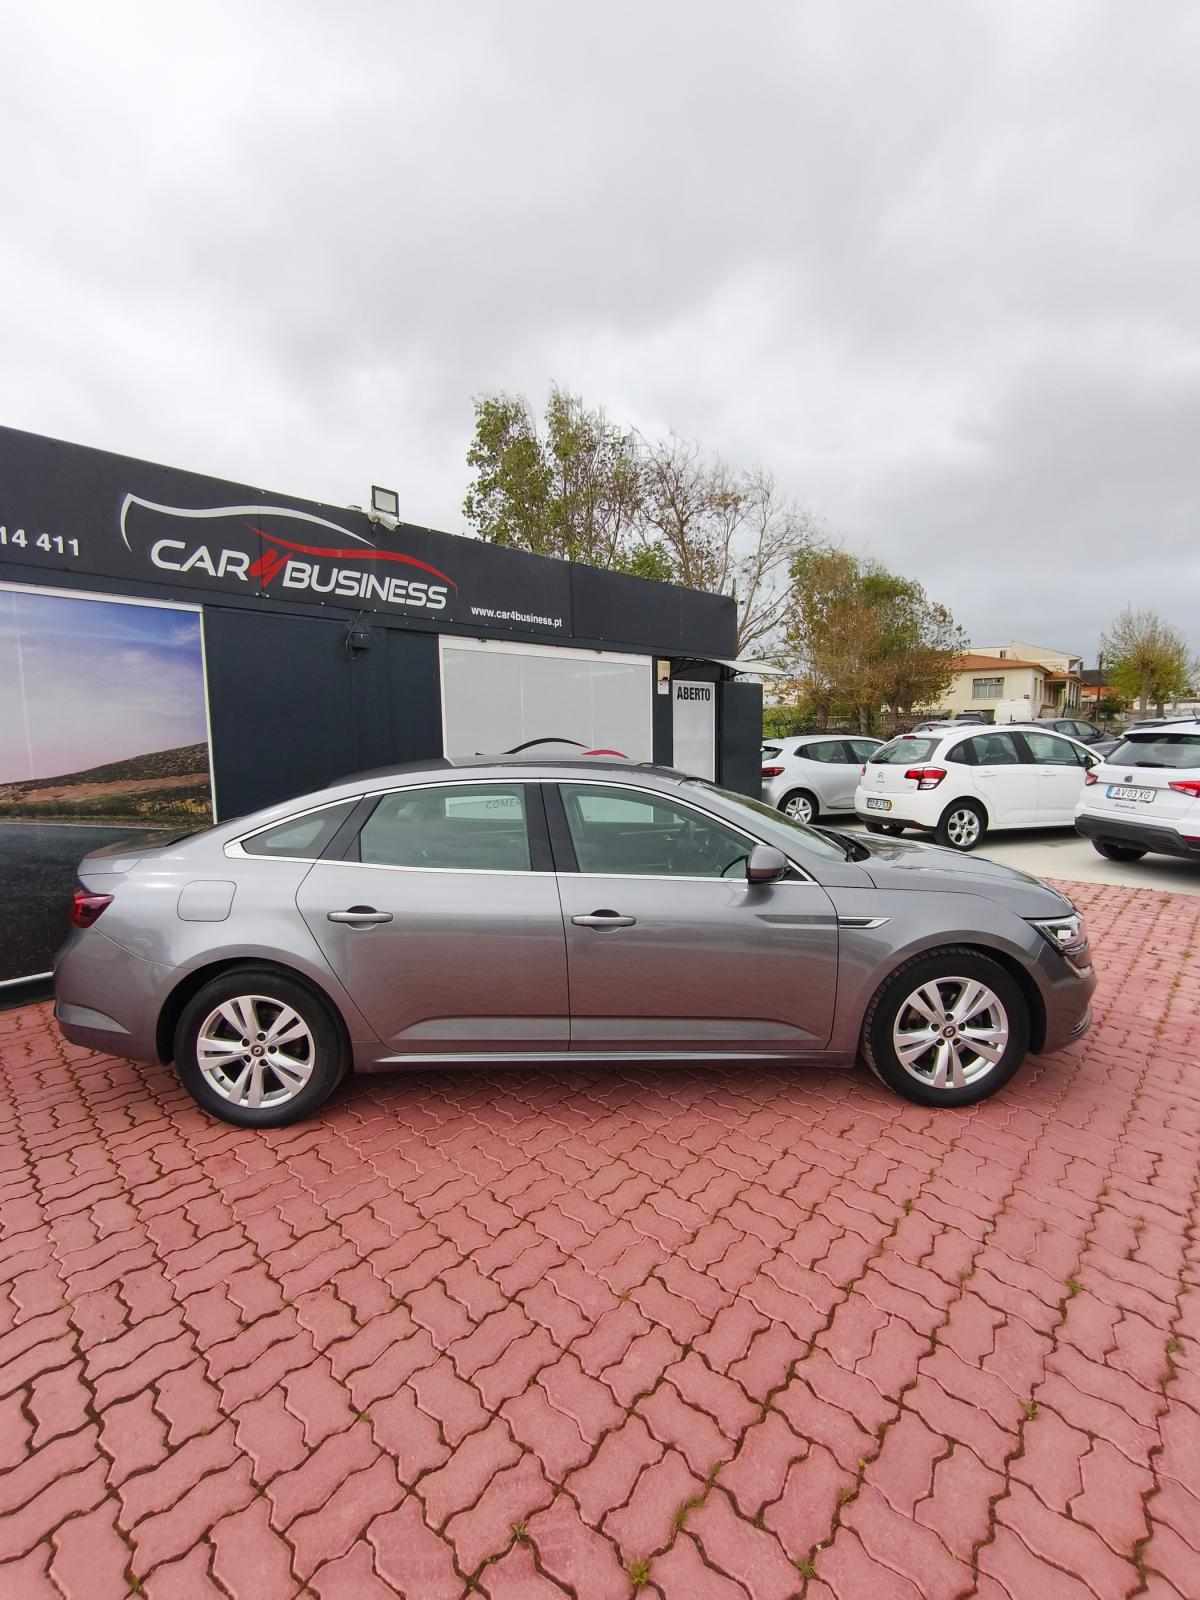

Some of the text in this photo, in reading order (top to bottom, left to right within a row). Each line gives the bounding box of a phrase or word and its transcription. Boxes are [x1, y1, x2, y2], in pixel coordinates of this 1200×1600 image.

[36, 533, 79, 556] 411
[470, 606, 563, 628] www.car4business.pt
[676, 686, 711, 701] ABERTO
